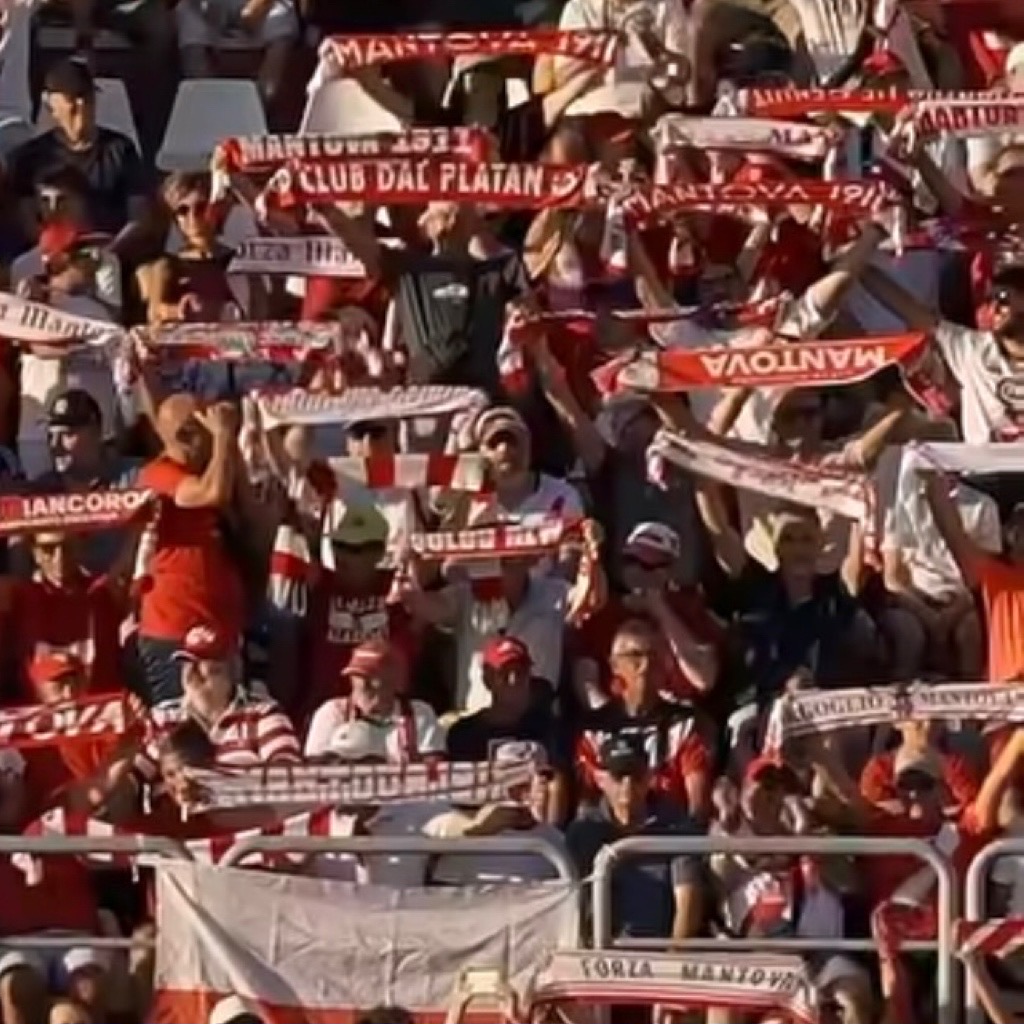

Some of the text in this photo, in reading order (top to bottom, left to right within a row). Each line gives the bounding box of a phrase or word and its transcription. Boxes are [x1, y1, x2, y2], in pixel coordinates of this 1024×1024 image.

[331, 33, 537, 66] MANTOVA
[297, 162, 366, 194] CLUB
[700, 346, 888, 378] MANTOVA
[579, 957, 655, 979] FORZA
